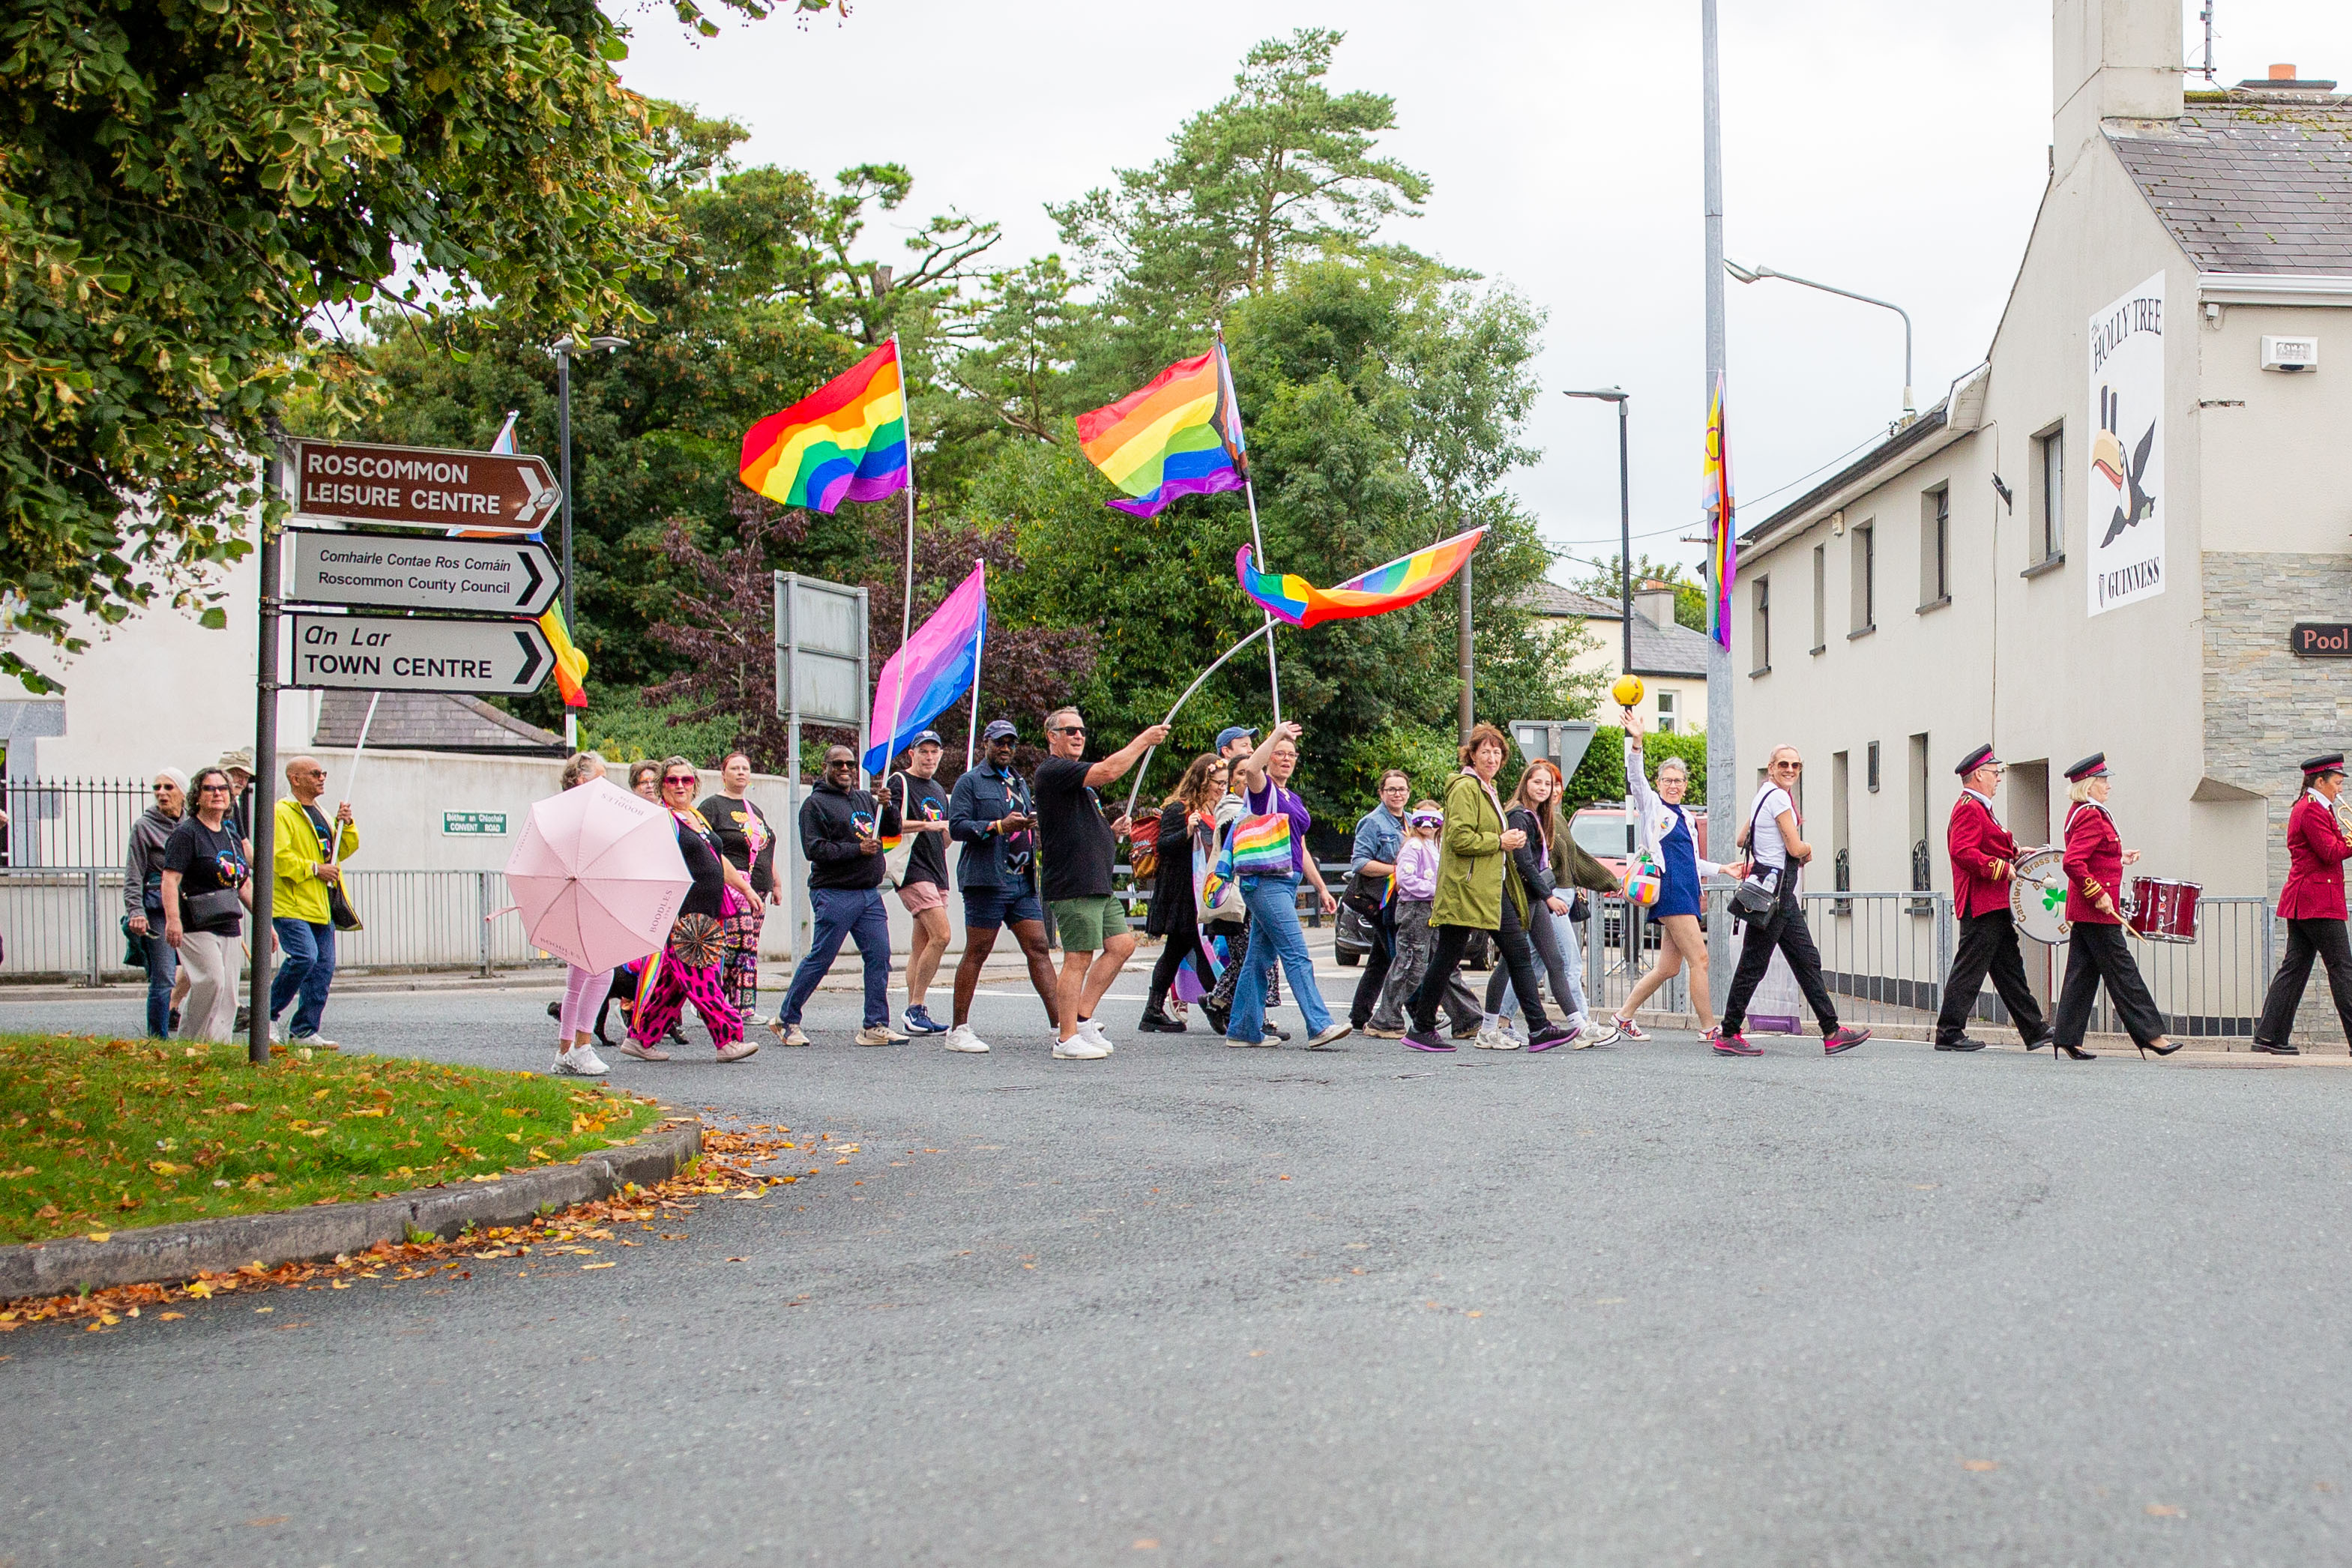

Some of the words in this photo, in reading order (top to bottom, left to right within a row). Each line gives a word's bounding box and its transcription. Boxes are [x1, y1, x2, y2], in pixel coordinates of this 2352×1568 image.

[2094, 303, 2130, 375] HOLLY
[2132, 298, 2162, 336] TREE
[307, 453, 468, 484] ROSCOMMON
[306, 482, 400, 507] LEISURE
[411, 489, 501, 515] CENTRE
[319, 549, 383, 565] Comhairle
[387, 553, 432, 567] Contae
[435, 555, 460, 570] Ros
[464, 558, 511, 573] Comáin
[319, 571, 403, 588] Roscommon
[408, 576, 456, 594] County
[461, 579, 510, 594] Council
[2108, 556, 2159, 599] GUINNESS
[2303, 628, 2348, 650] Pool
[304, 654, 381, 675] TOWN
[392, 657, 492, 678] CENTRE
[450, 823, 478, 832] CONVENT
[484, 824, 501, 833] ROAD
[2022, 857, 2050, 875] Brass
[2054, 854, 2060, 863] &
[649, 889, 673, 933] BOODLES
